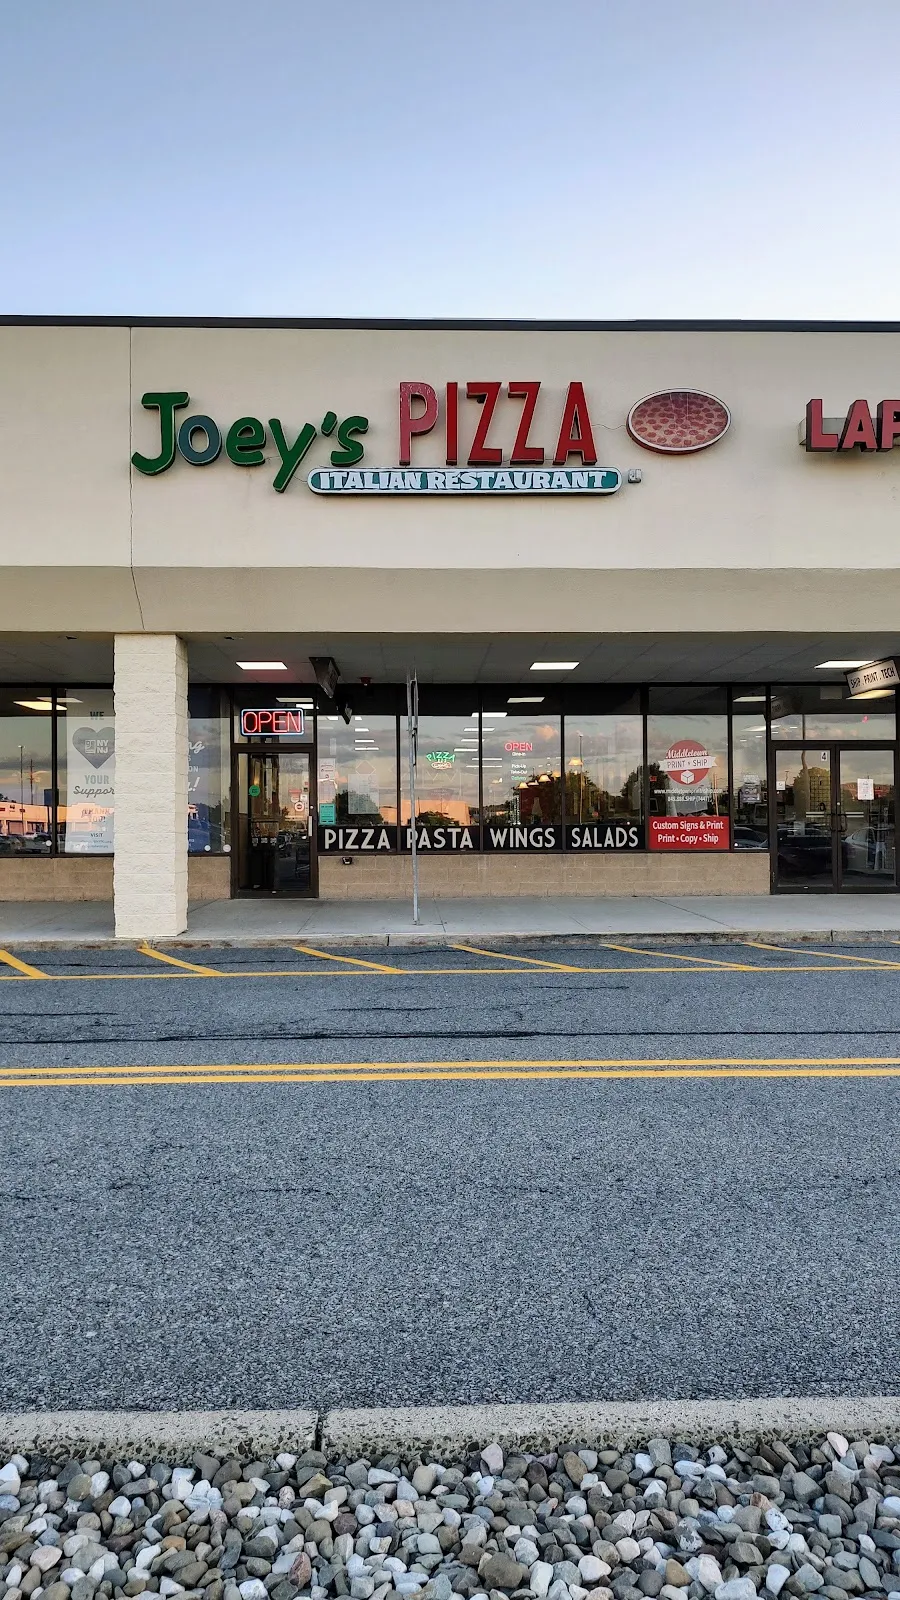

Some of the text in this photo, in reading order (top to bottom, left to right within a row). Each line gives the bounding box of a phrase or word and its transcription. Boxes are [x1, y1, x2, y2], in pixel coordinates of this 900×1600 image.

[130, 382, 598, 493] Joey's PIZZA
[319, 471, 607, 490] ITALIAN RESTAURANT
[863, 671, 879, 685] PRINT
[880, 666, 896, 679] TECH
[90, 711, 105, 720] WE
[243, 711, 301, 732] OPEN
[96, 739, 109, 747] NY
[504, 742, 533, 751] OPEN
[426, 751, 456, 763] PIZZA
[665, 748, 708, 759] Middletown
[821, 752, 827, 760] 4
[667, 758, 708, 769] PRINT SHIP
[84, 774, 110, 785] YOUR
[73, 785, 115, 798] Suppor
[652, 821, 724, 832] Custom Signs & Print
[324, 828, 391, 850] PIZZA
[406, 828, 474, 849] PASTA
[489, 827, 556, 848] WINGS
[571, 827, 639, 848] SALADS
[657, 834, 719, 845] Print Copy Ship
